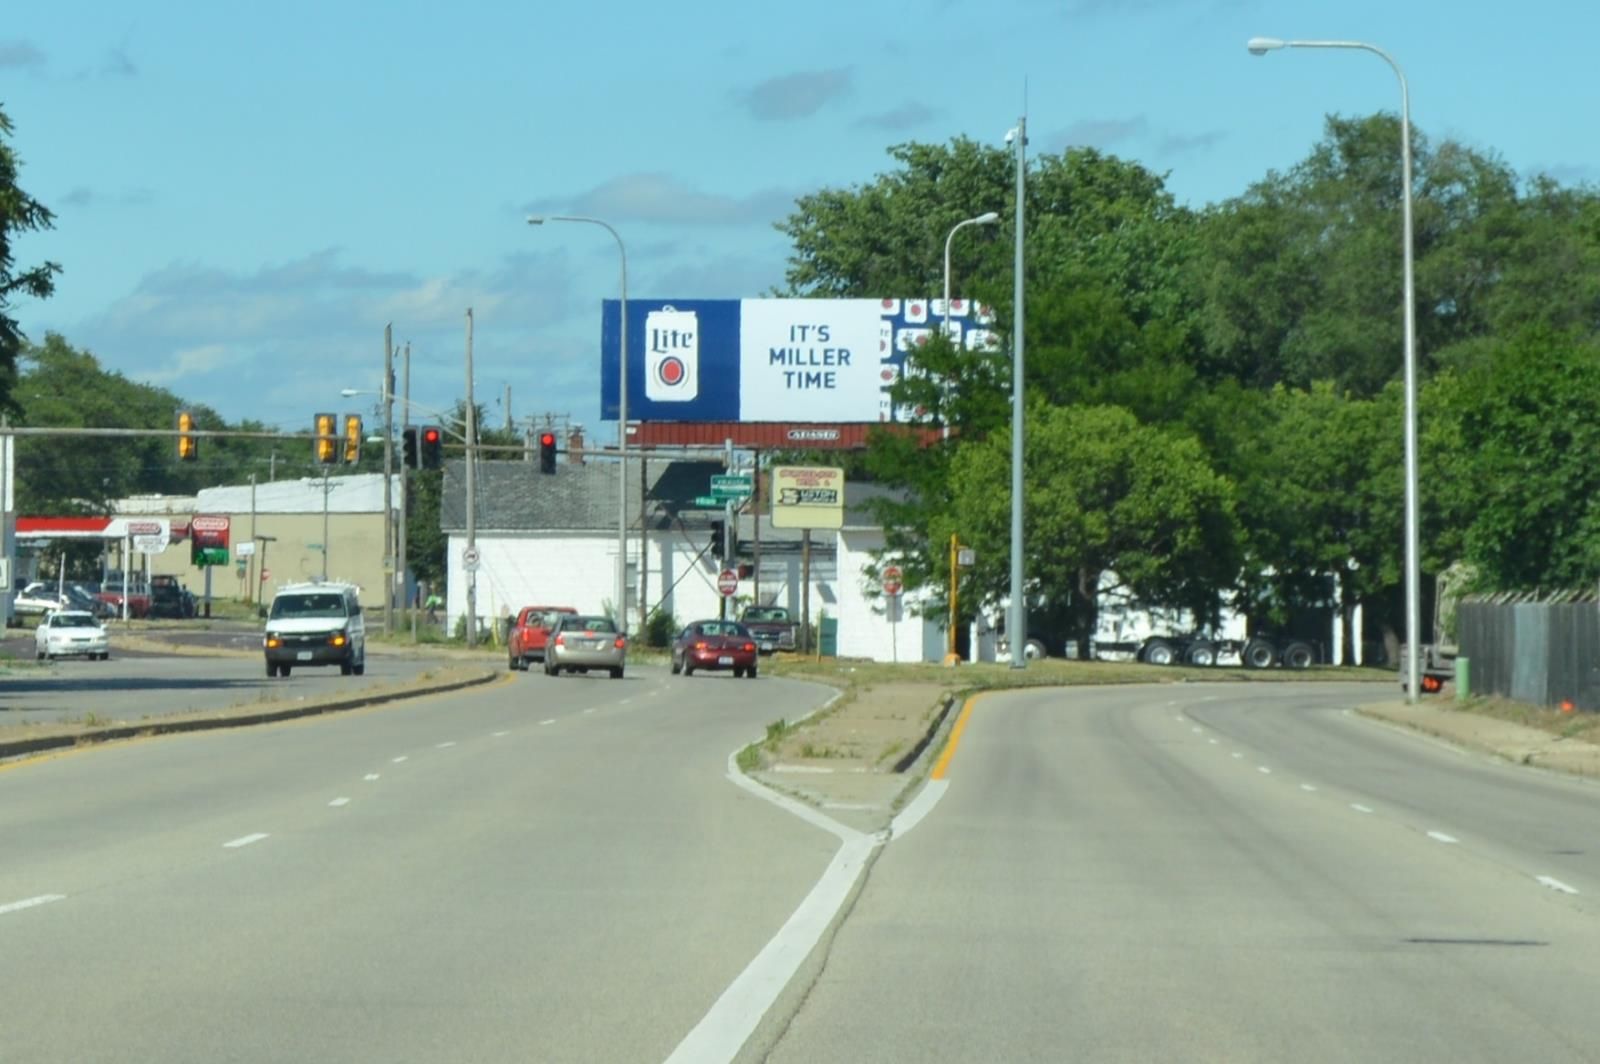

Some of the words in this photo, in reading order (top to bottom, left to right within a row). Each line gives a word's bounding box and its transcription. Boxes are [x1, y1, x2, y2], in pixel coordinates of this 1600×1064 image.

[651, 328, 693, 353] Lite
[790, 325, 830, 342] IT'S
[769, 348, 851, 365] MILLER
[783, 371, 836, 389] TIME
